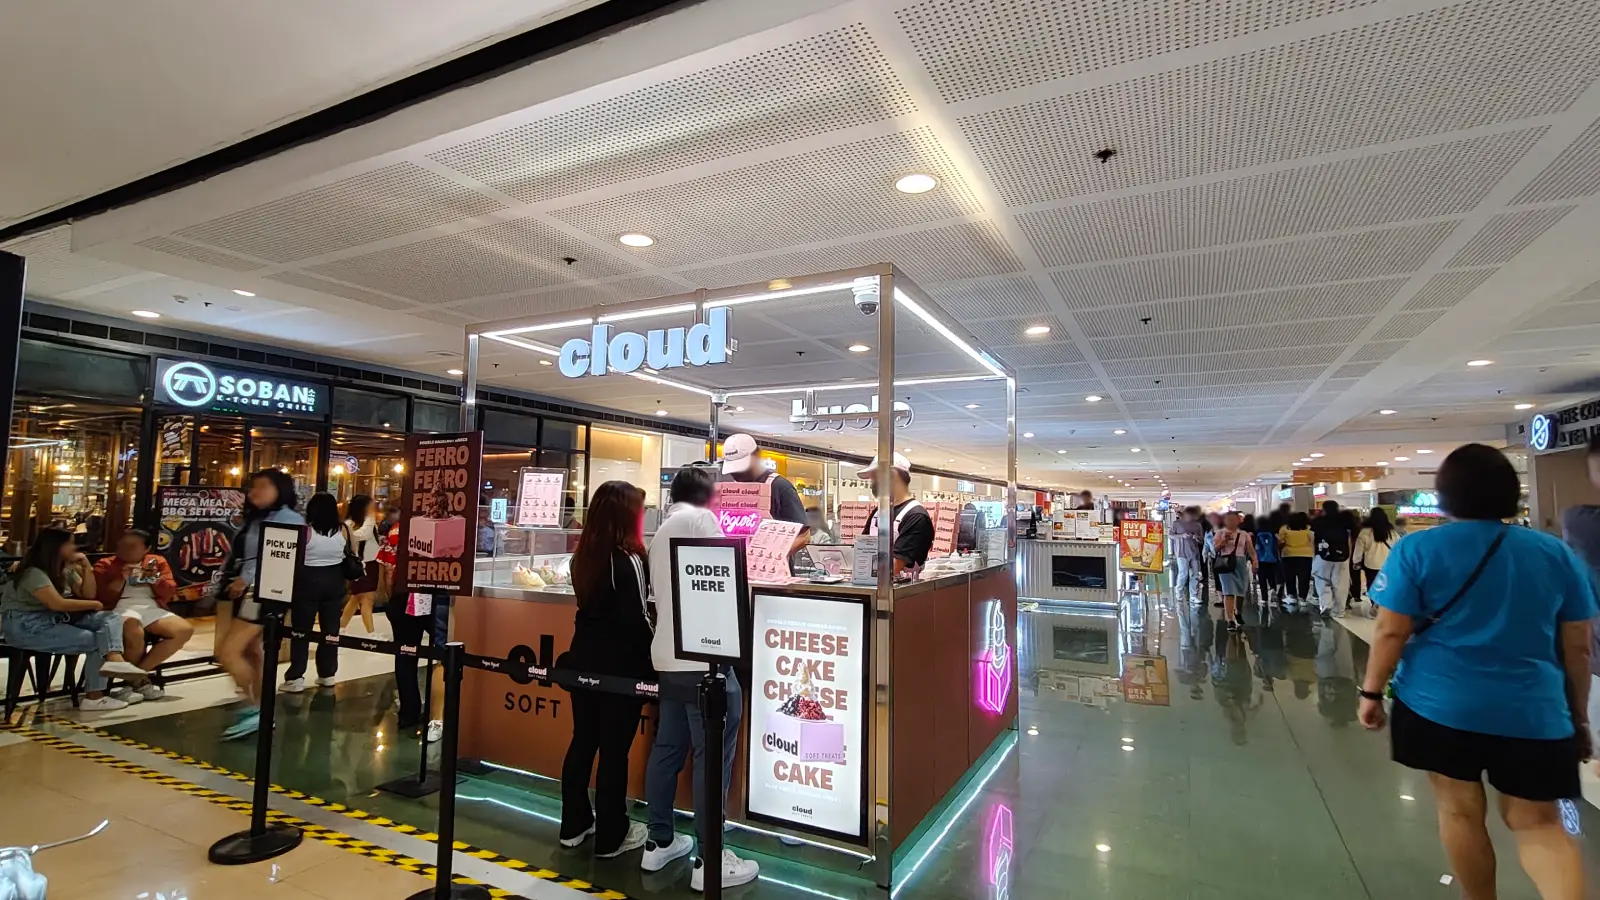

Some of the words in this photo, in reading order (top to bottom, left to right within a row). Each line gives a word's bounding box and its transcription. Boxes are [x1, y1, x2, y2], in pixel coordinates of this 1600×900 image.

[559, 306, 730, 377] cloud
[219, 376, 308, 404] SOBAN
[216, 395, 269, 407] K-TOWN
[277, 402, 314, 412] GRILL
[416, 445, 469, 467] FERRO
[163, 498, 196, 507] MEGA
[200, 498, 228, 507] MEAT
[162, 507, 187, 516] BBQ
[189, 507, 206, 516] SET
[209, 507, 231, 516] FOR
[233, 508, 241, 516] 2
[718, 510, 758, 532] Yogurt
[1140, 523, 1147, 537] 1
[266, 539, 285, 549] PICK
[287, 541, 297, 550] UP
[409, 536, 433, 554] cloud
[270, 550, 291, 560] HERE
[407, 561, 462, 582] FERRO
[685, 564, 730, 578] ORDER
[691, 579, 725, 592] HERE
[701, 637, 721, 646] cloud
[764, 628, 849, 657] CHEESE
[528, 665, 547, 676] cloud
[636, 681, 659, 693] cloud
[504, 692, 561, 719] SOFT
[766, 732, 799, 757] cloud
[804, 752, 820, 760] SOFT
[821, 752, 842, 760] TREATS
[773, 760, 833, 791] CAKE
[791, 805, 813, 815] cloud
